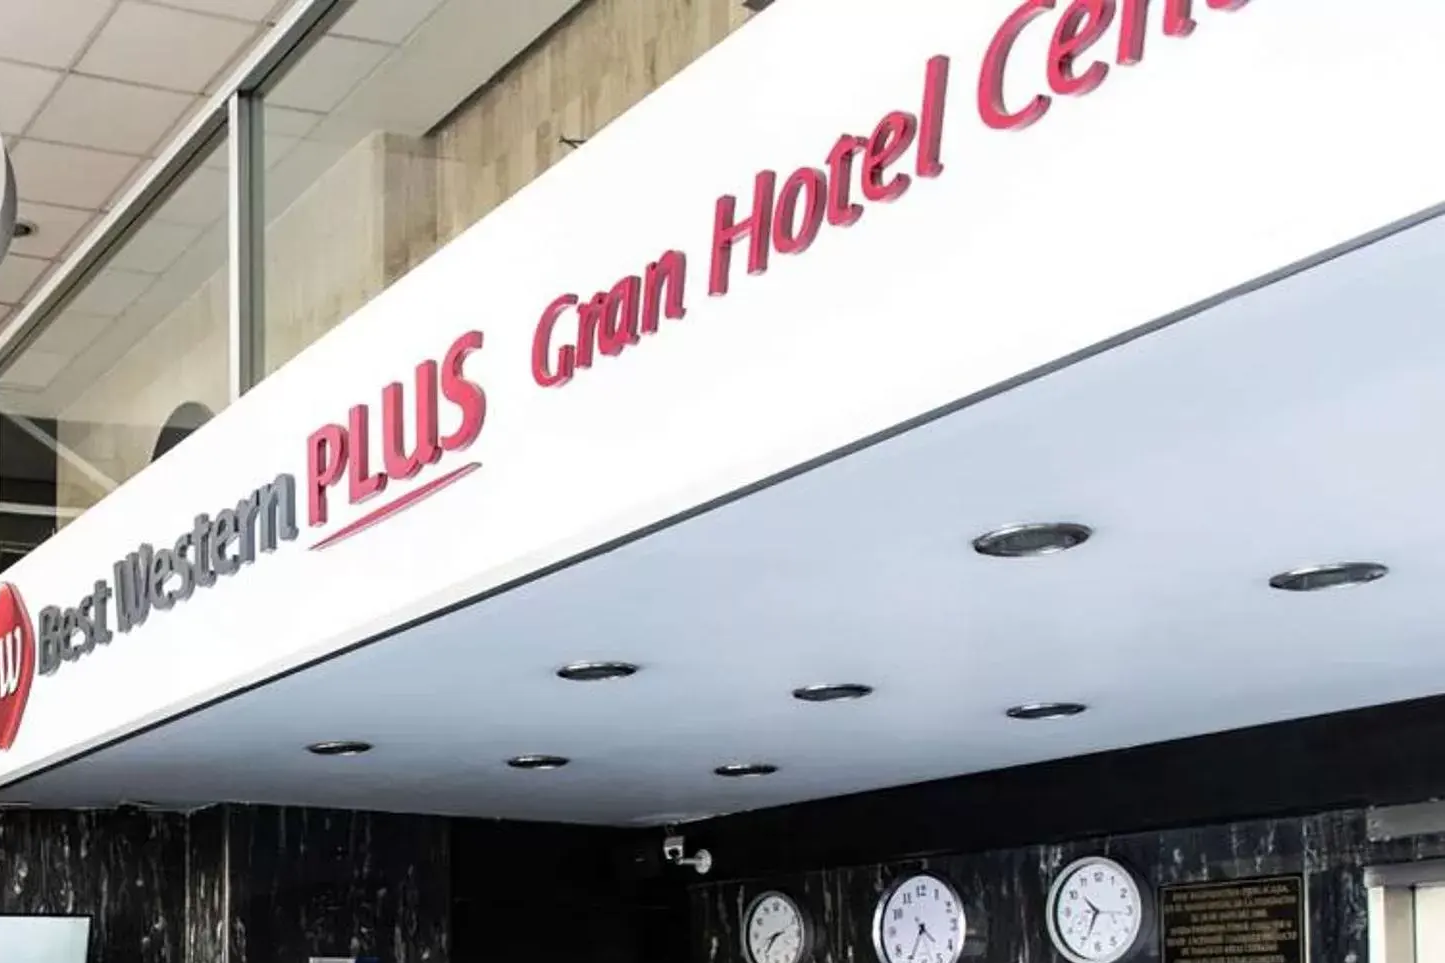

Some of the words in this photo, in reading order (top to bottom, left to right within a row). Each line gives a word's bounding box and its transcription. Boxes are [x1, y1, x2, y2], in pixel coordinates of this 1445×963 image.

[38, 580, 114, 677] Best
[113, 473, 300, 633] Western
[307, 330, 488, 527] PLUS
[530, 249, 686, 389] Gran
[708, 54, 950, 296] Hotel
[976, 0, 1250, 131] Cen
